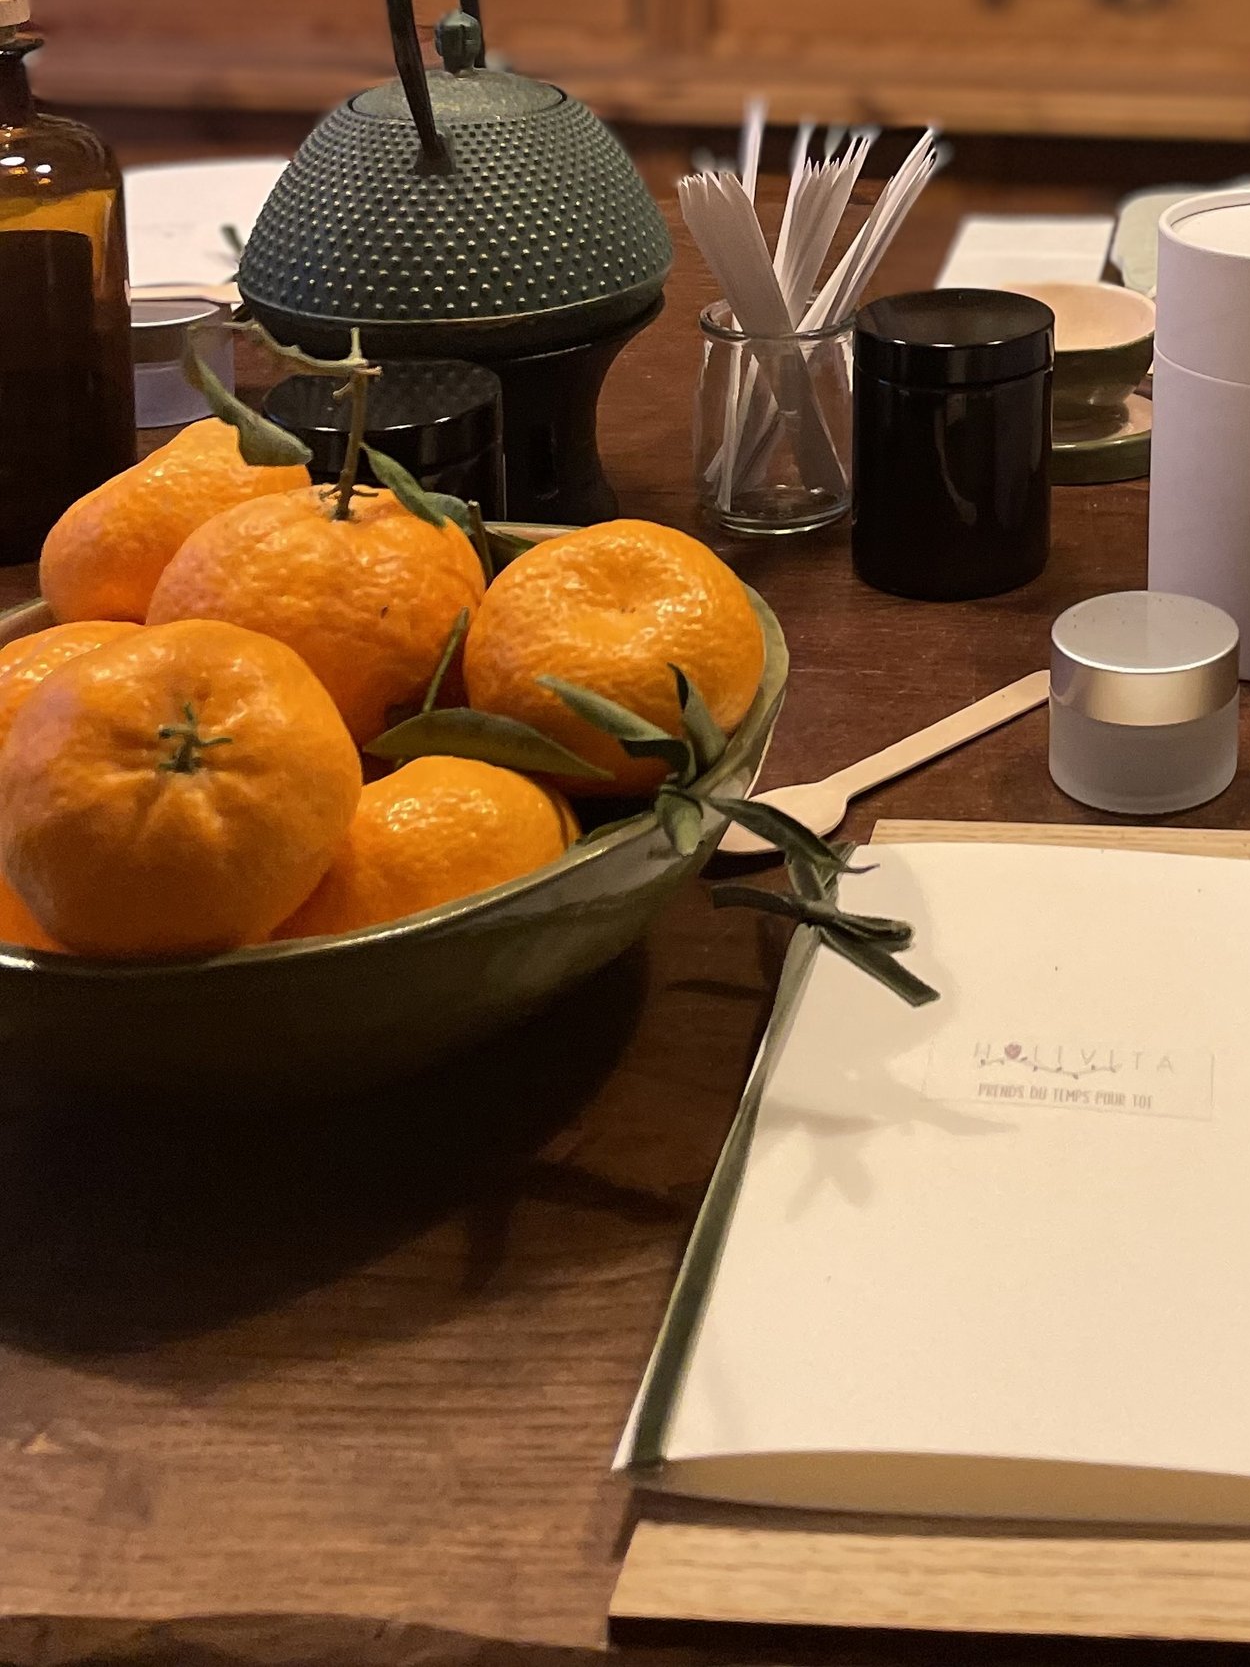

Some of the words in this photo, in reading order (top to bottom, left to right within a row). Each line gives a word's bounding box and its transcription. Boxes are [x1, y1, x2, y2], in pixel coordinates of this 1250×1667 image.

[978, 1082, 1025, 1099] PRENDS
[1030, 1085, 1047, 1101] DU
[1054, 1087, 1090, 1104] TEMPS
[1095, 1090, 1127, 1107] POUR
